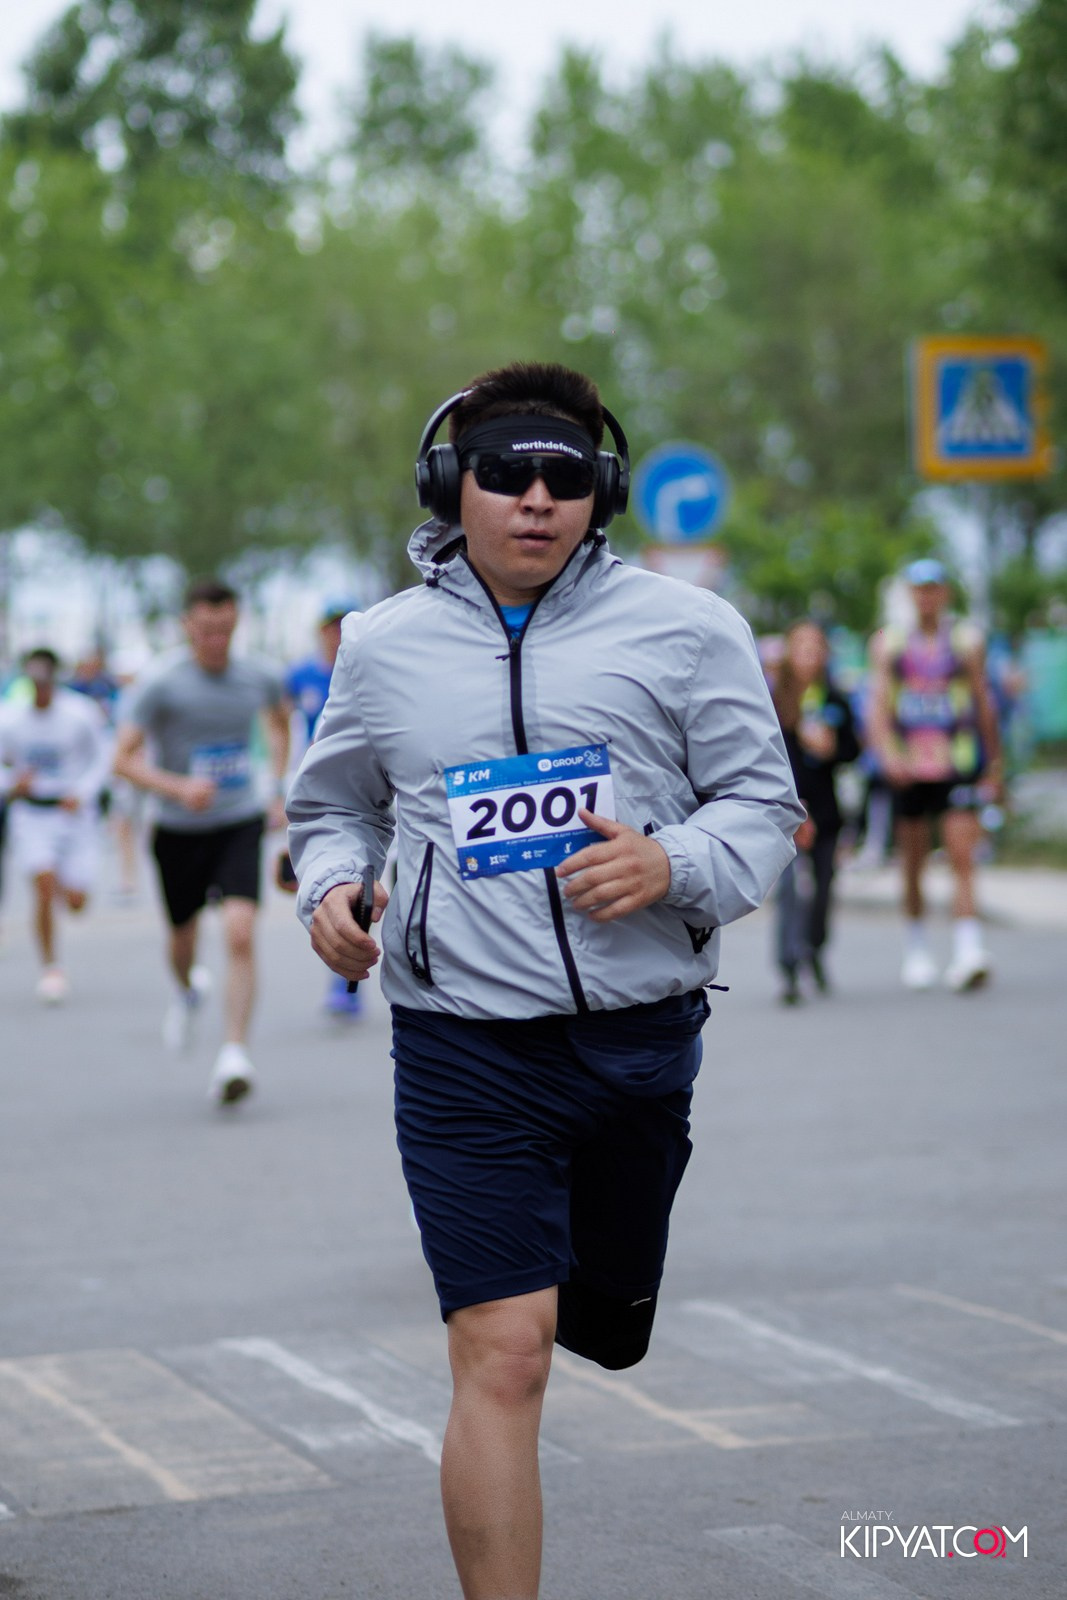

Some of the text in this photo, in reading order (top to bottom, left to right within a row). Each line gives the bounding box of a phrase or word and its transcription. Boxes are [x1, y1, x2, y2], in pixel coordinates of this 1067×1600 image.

[512, 440, 583, 459] worthdefence
[552, 755, 584, 768] GROUP
[452, 770, 465, 786] 5
[468, 768, 491, 783] KM
[466, 781, 599, 841] 2001
